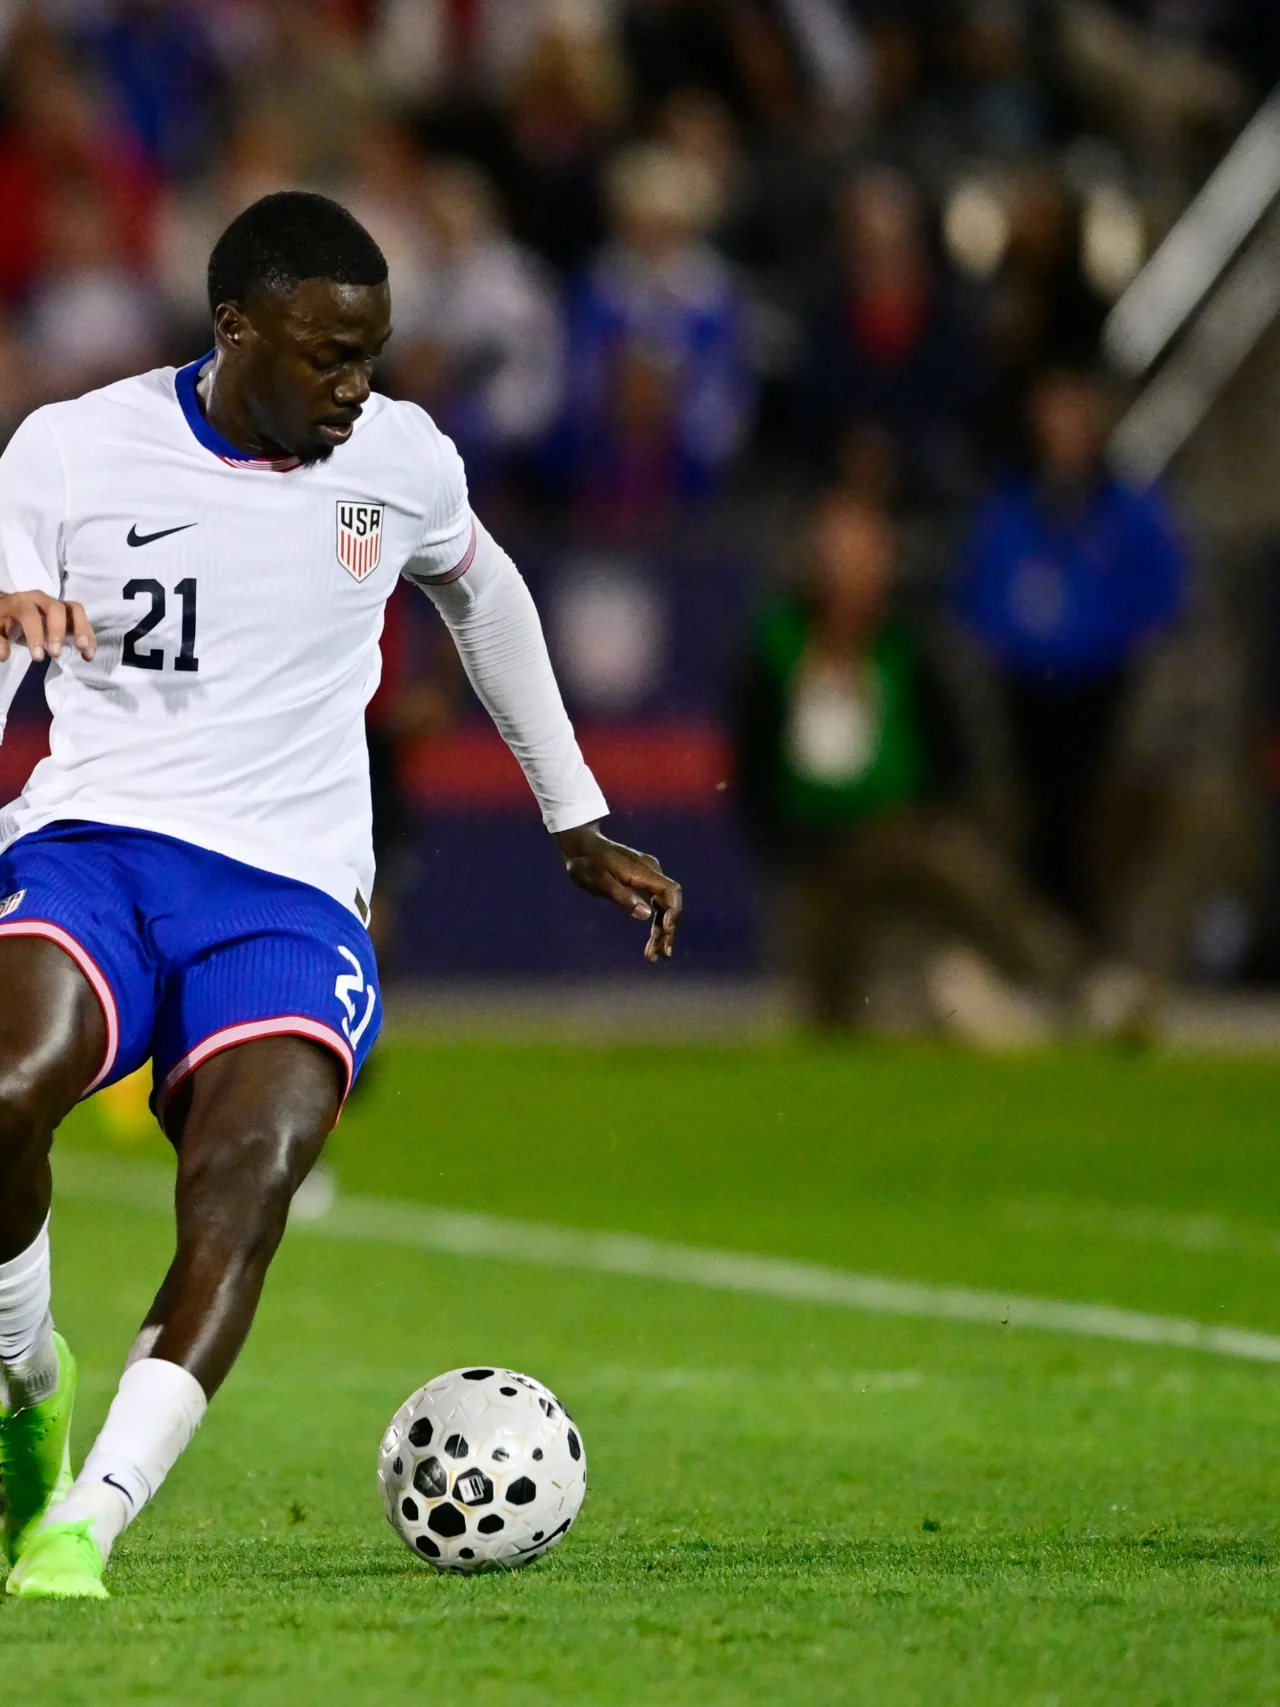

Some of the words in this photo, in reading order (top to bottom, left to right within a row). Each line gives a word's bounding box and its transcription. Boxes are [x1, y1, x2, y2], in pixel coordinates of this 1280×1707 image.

[341, 506, 381, 537] USA
[121, 578, 199, 672] 21
[335, 945, 377, 1051] 21
